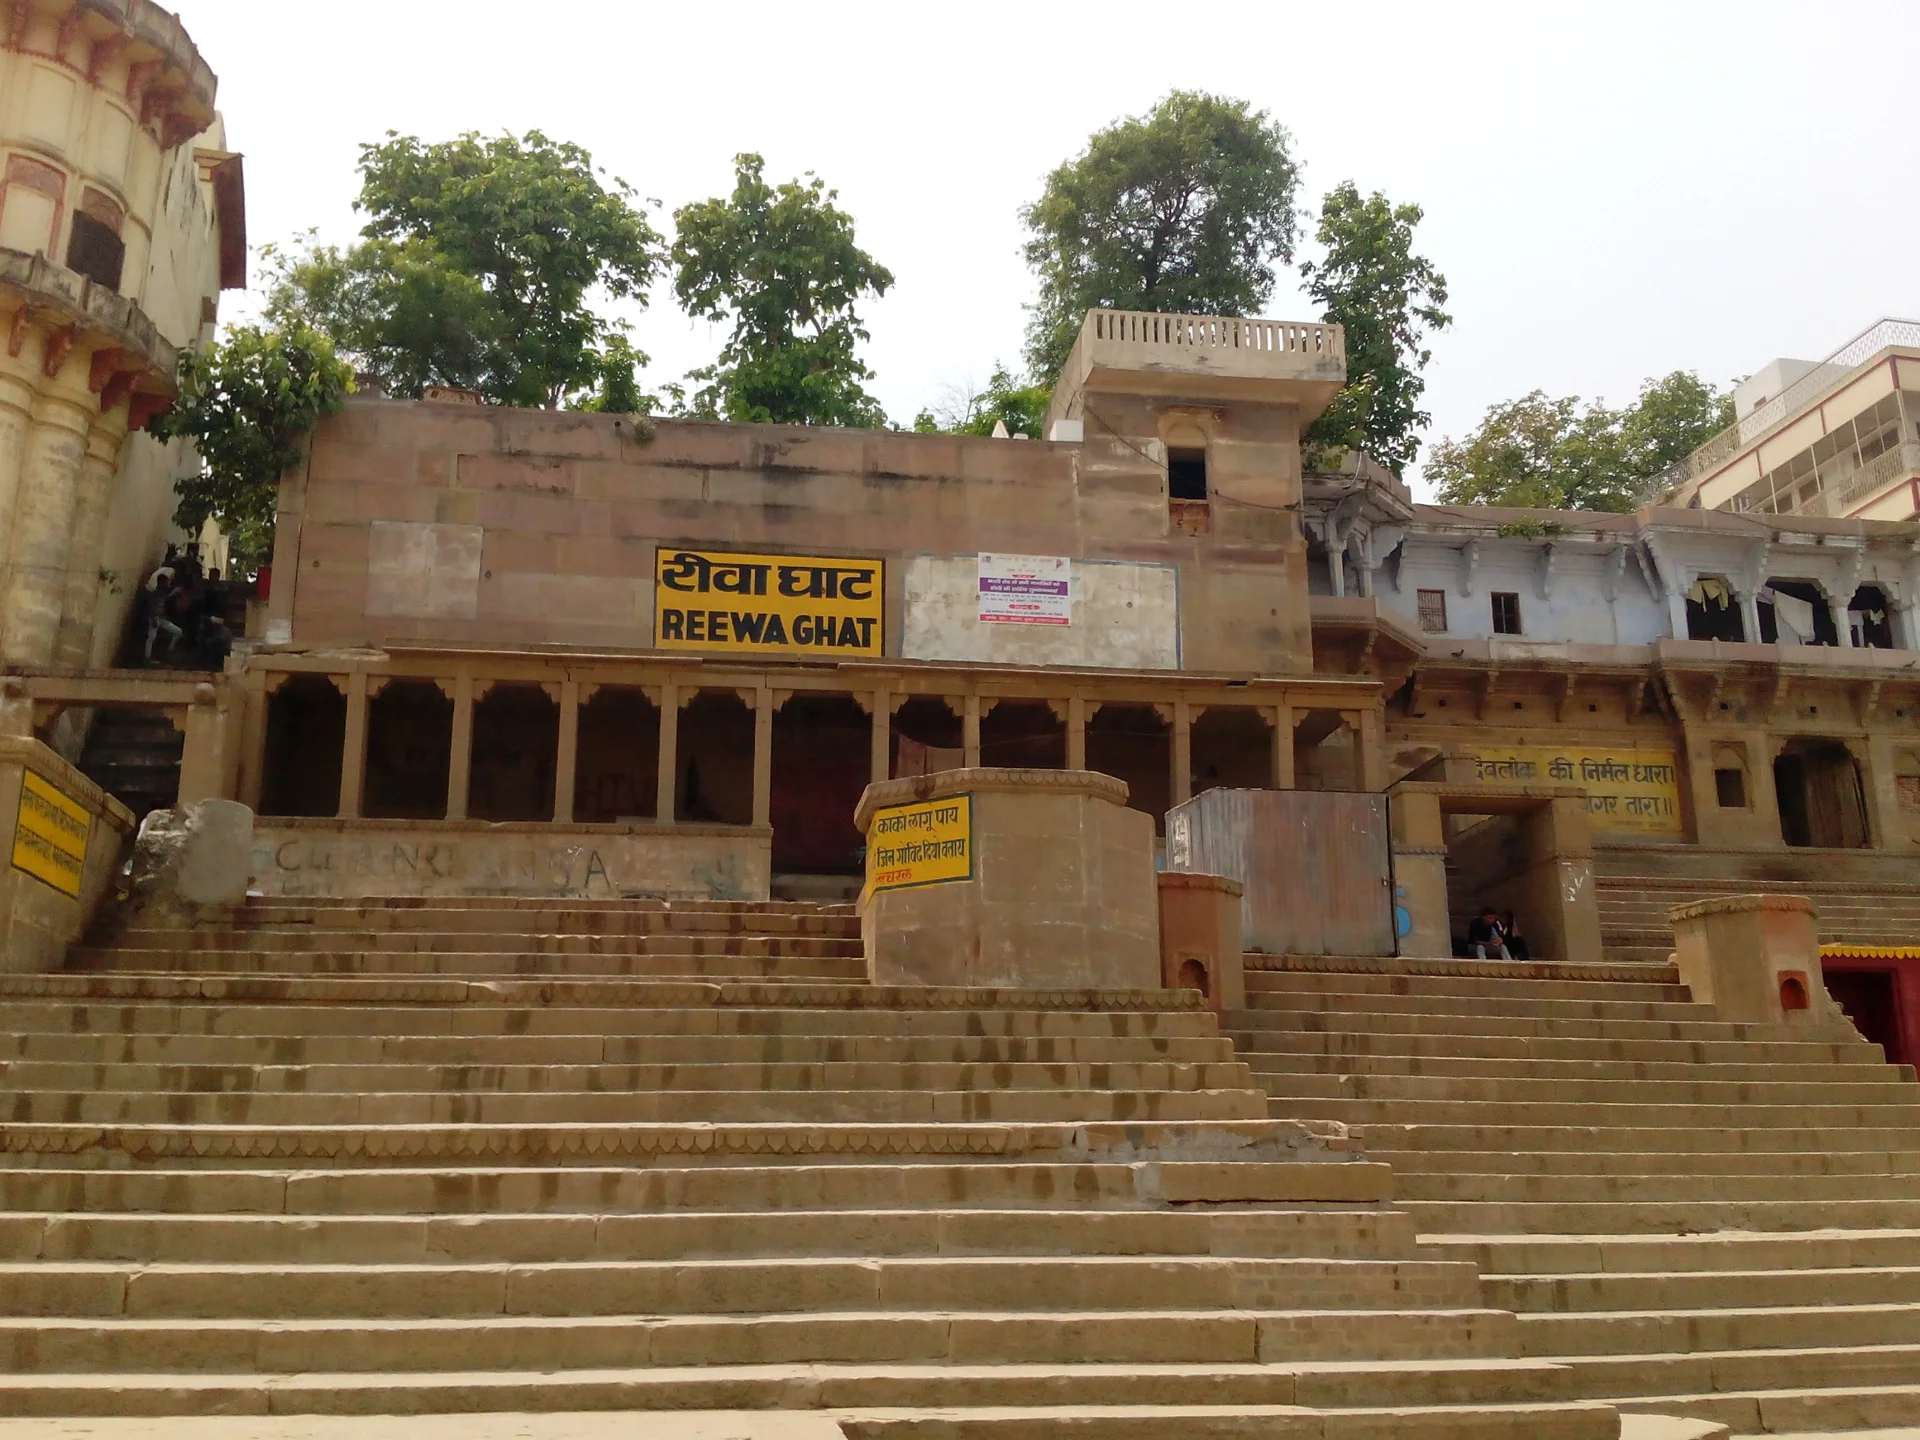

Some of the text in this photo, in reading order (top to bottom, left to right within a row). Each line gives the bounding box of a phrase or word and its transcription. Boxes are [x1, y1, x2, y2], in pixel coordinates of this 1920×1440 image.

[662, 553, 876, 600] रीवा घाट
[662, 609, 878, 648] REEWA GHAT
[1548, 757, 1575, 780] की
[1579, 757, 1630, 783] निर्मल
[935, 806, 959, 826] पाय
[876, 846, 895, 867] जिन
